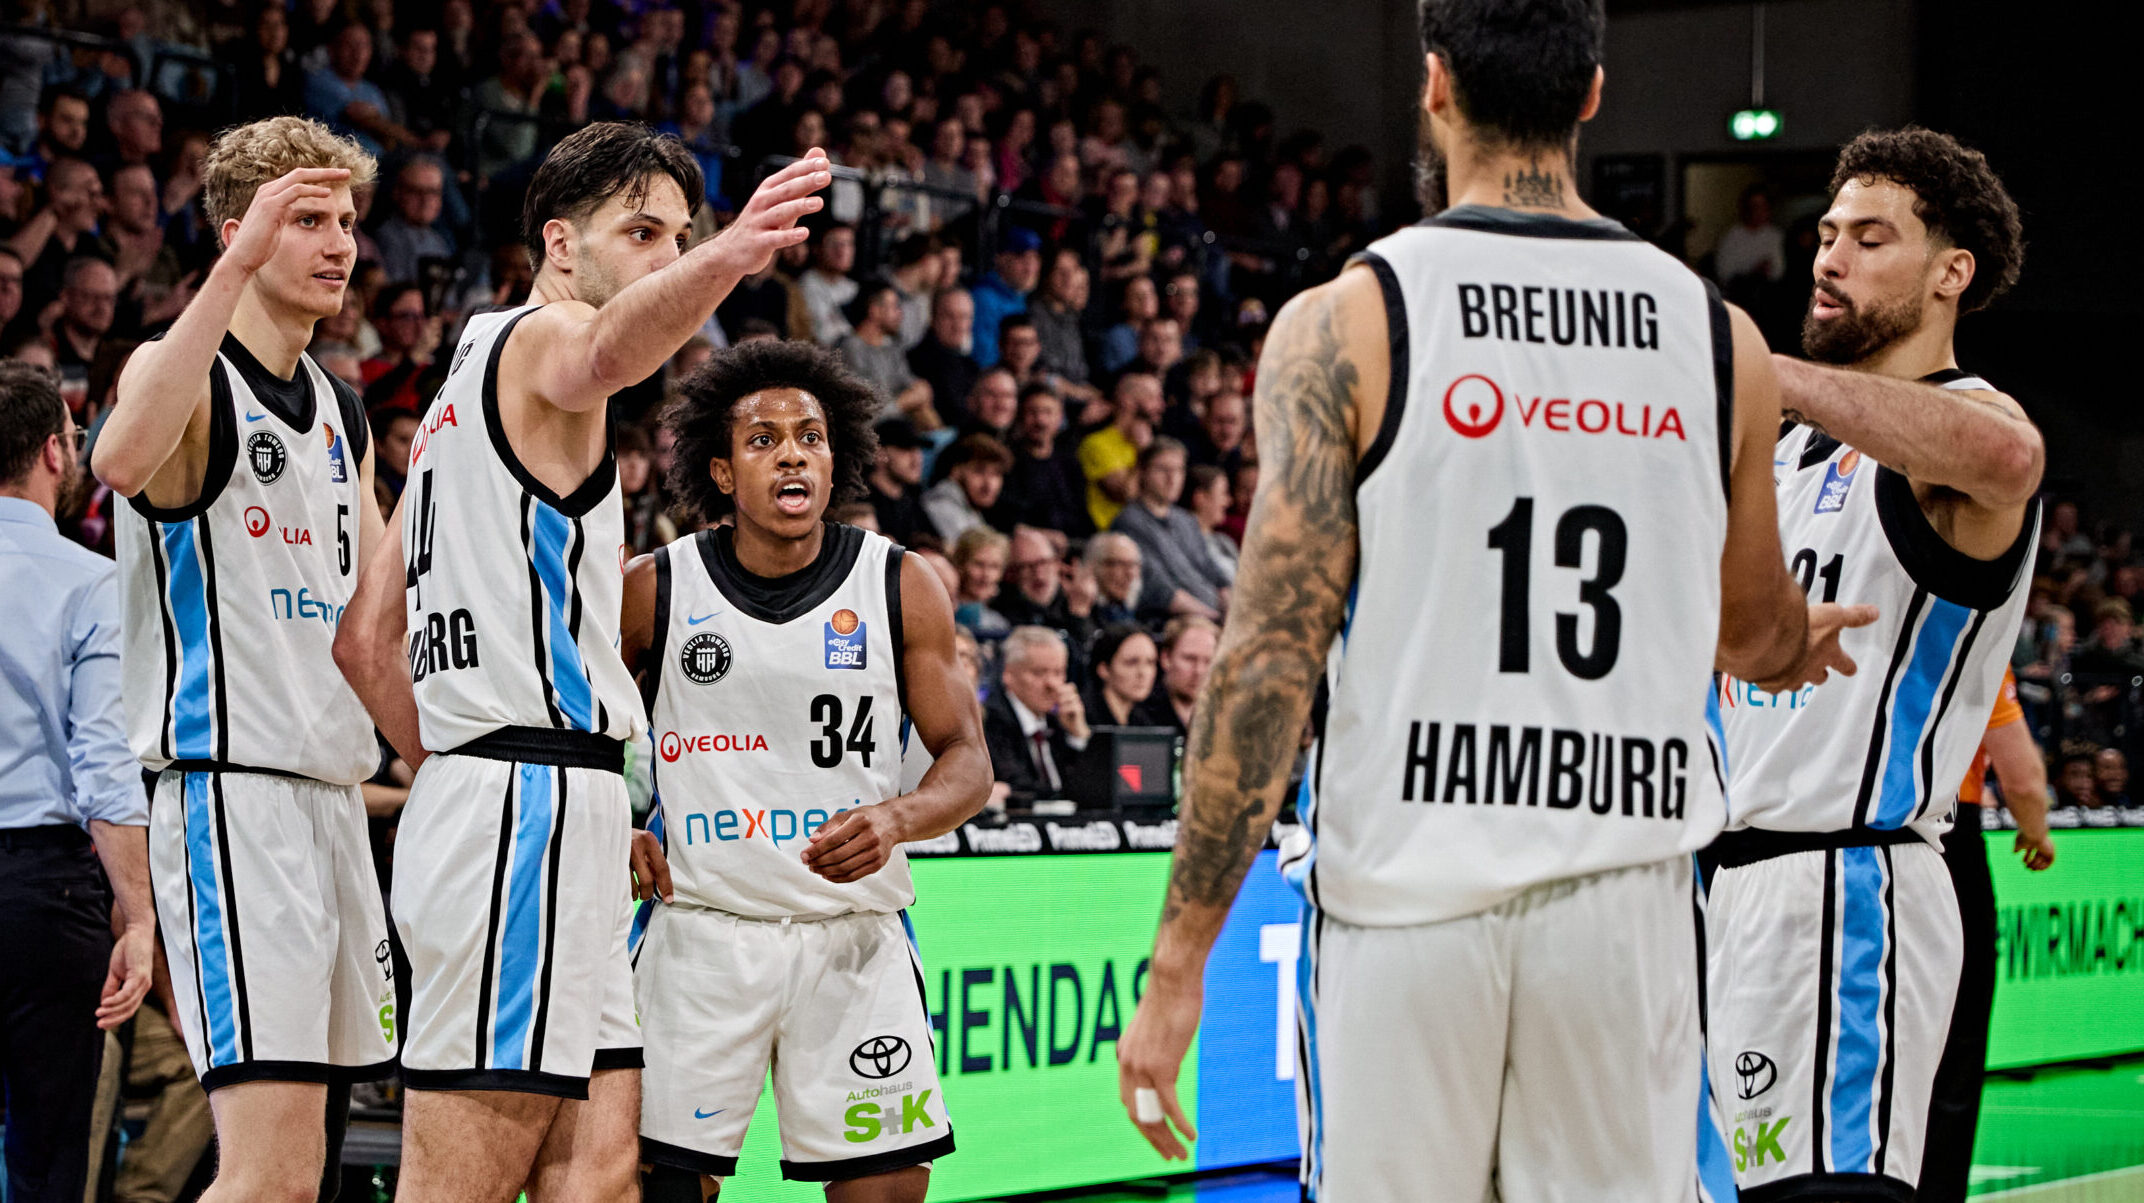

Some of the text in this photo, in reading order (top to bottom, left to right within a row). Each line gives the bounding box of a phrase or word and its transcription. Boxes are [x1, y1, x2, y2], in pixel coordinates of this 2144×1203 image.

[1458, 284, 1659, 350] BREUNIG
[1515, 394, 1687, 441] VEOLIA
[337, 503, 351, 577] 5
[1487, 496, 1628, 681] 13
[682, 635, 730, 659] VEOLIA TOWERS
[828, 651, 863, 666] BBL
[682, 734, 769, 753] VEOLIA
[809, 693, 876, 769] 34
[1402, 720, 1689, 820] HAMBURG
[685, 798, 862, 851] nexpe
[843, 1089, 936, 1144] S+K
[846, 1080, 913, 1103] Autohaus
